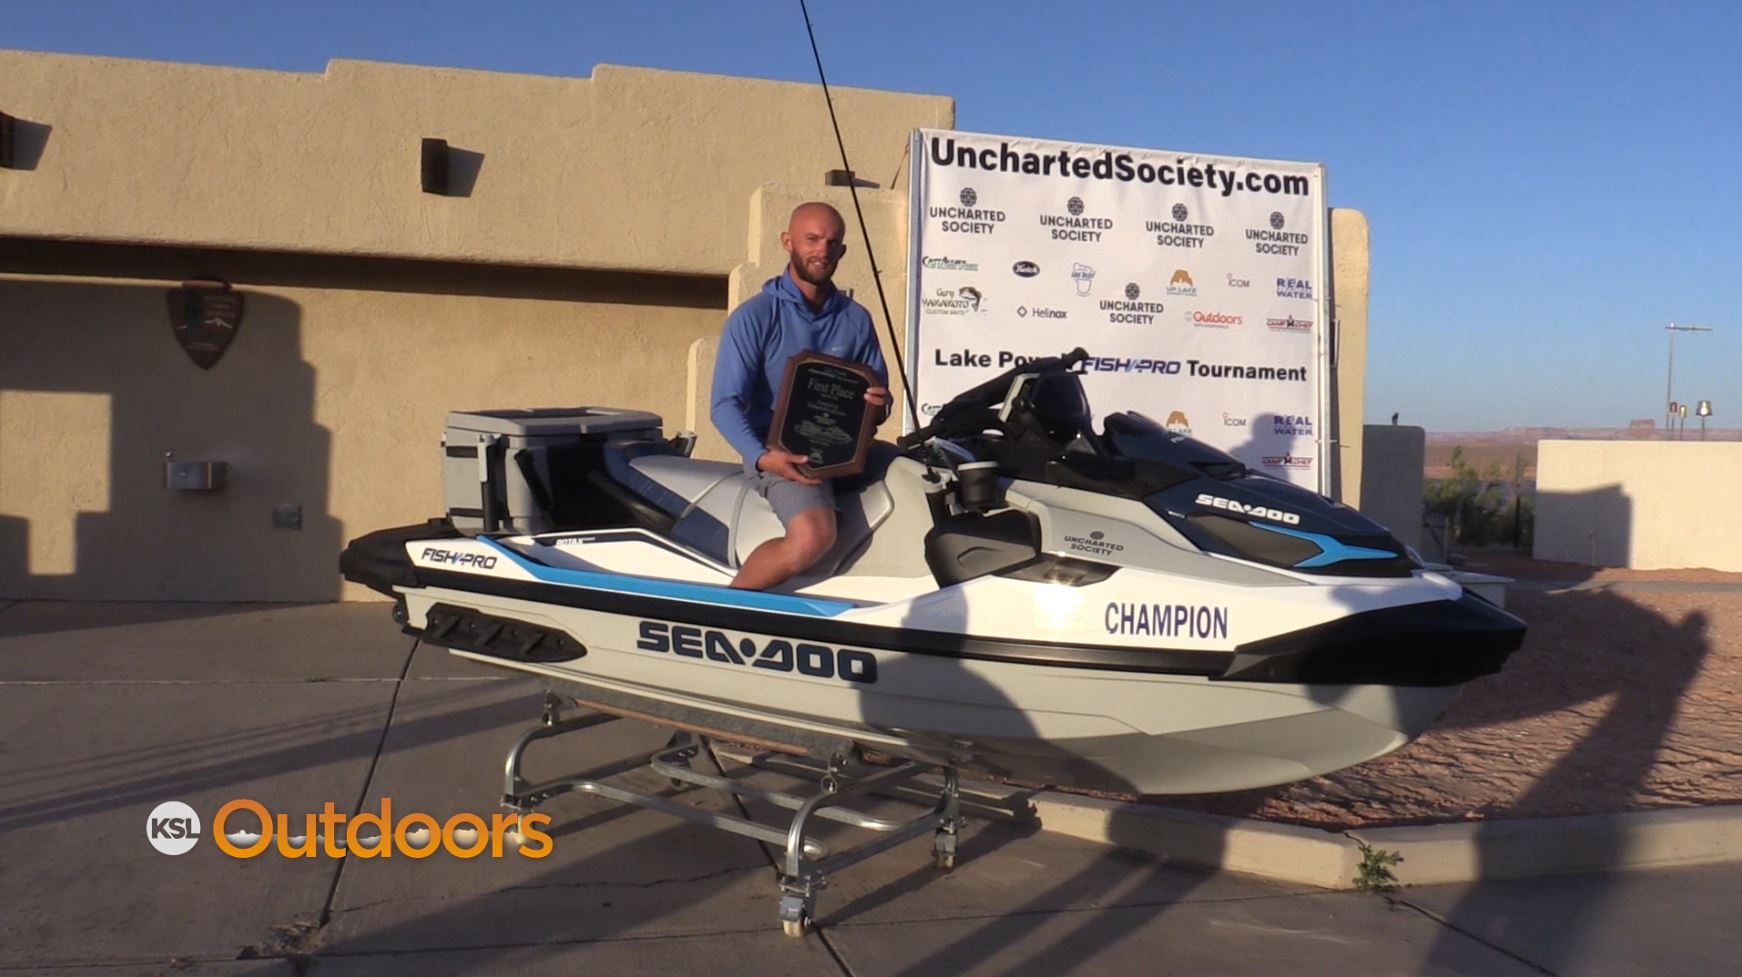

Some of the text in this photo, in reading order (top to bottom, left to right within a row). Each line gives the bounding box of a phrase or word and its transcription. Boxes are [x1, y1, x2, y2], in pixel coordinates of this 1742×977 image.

[931, 137, 1309, 197] UnchartedSociety.com
[929, 206, 1006, 222] UNCHARTED
[941, 220, 995, 235] SOCIETY
[1039, 215, 1113, 230] UNCHARTED
[1146, 220, 1215, 237] UNCHARTED
[1051, 229, 1102, 243] SOCIETY
[1156, 235, 1204, 249] SOCIETY
[1245, 229, 1309, 245] UNCHARTED
[1255, 242, 1300, 256] SOCIETY
[1276, 278, 1312, 289] REAL
[1276, 290, 1313, 300] WATER
[1032, 307, 1067, 319] Helinox
[1099, 300, 1164, 314] UNCHARTED
[1109, 313, 1154, 326] SOCIETY
[1193, 311, 1242, 325] Outdoors
[935, 349, 992, 368] Lake
[1187, 360, 1307, 381] Tournament
[807, 377, 856, 400] First Place
[1273, 415, 1312, 426] REAL
[1274, 427, 1313, 437] WATER
[1064, 535, 1124, 552] UNCHARTED
[1070, 543, 1113, 556] SOCIETY
[1104, 602, 1228, 640] CHAMPION
